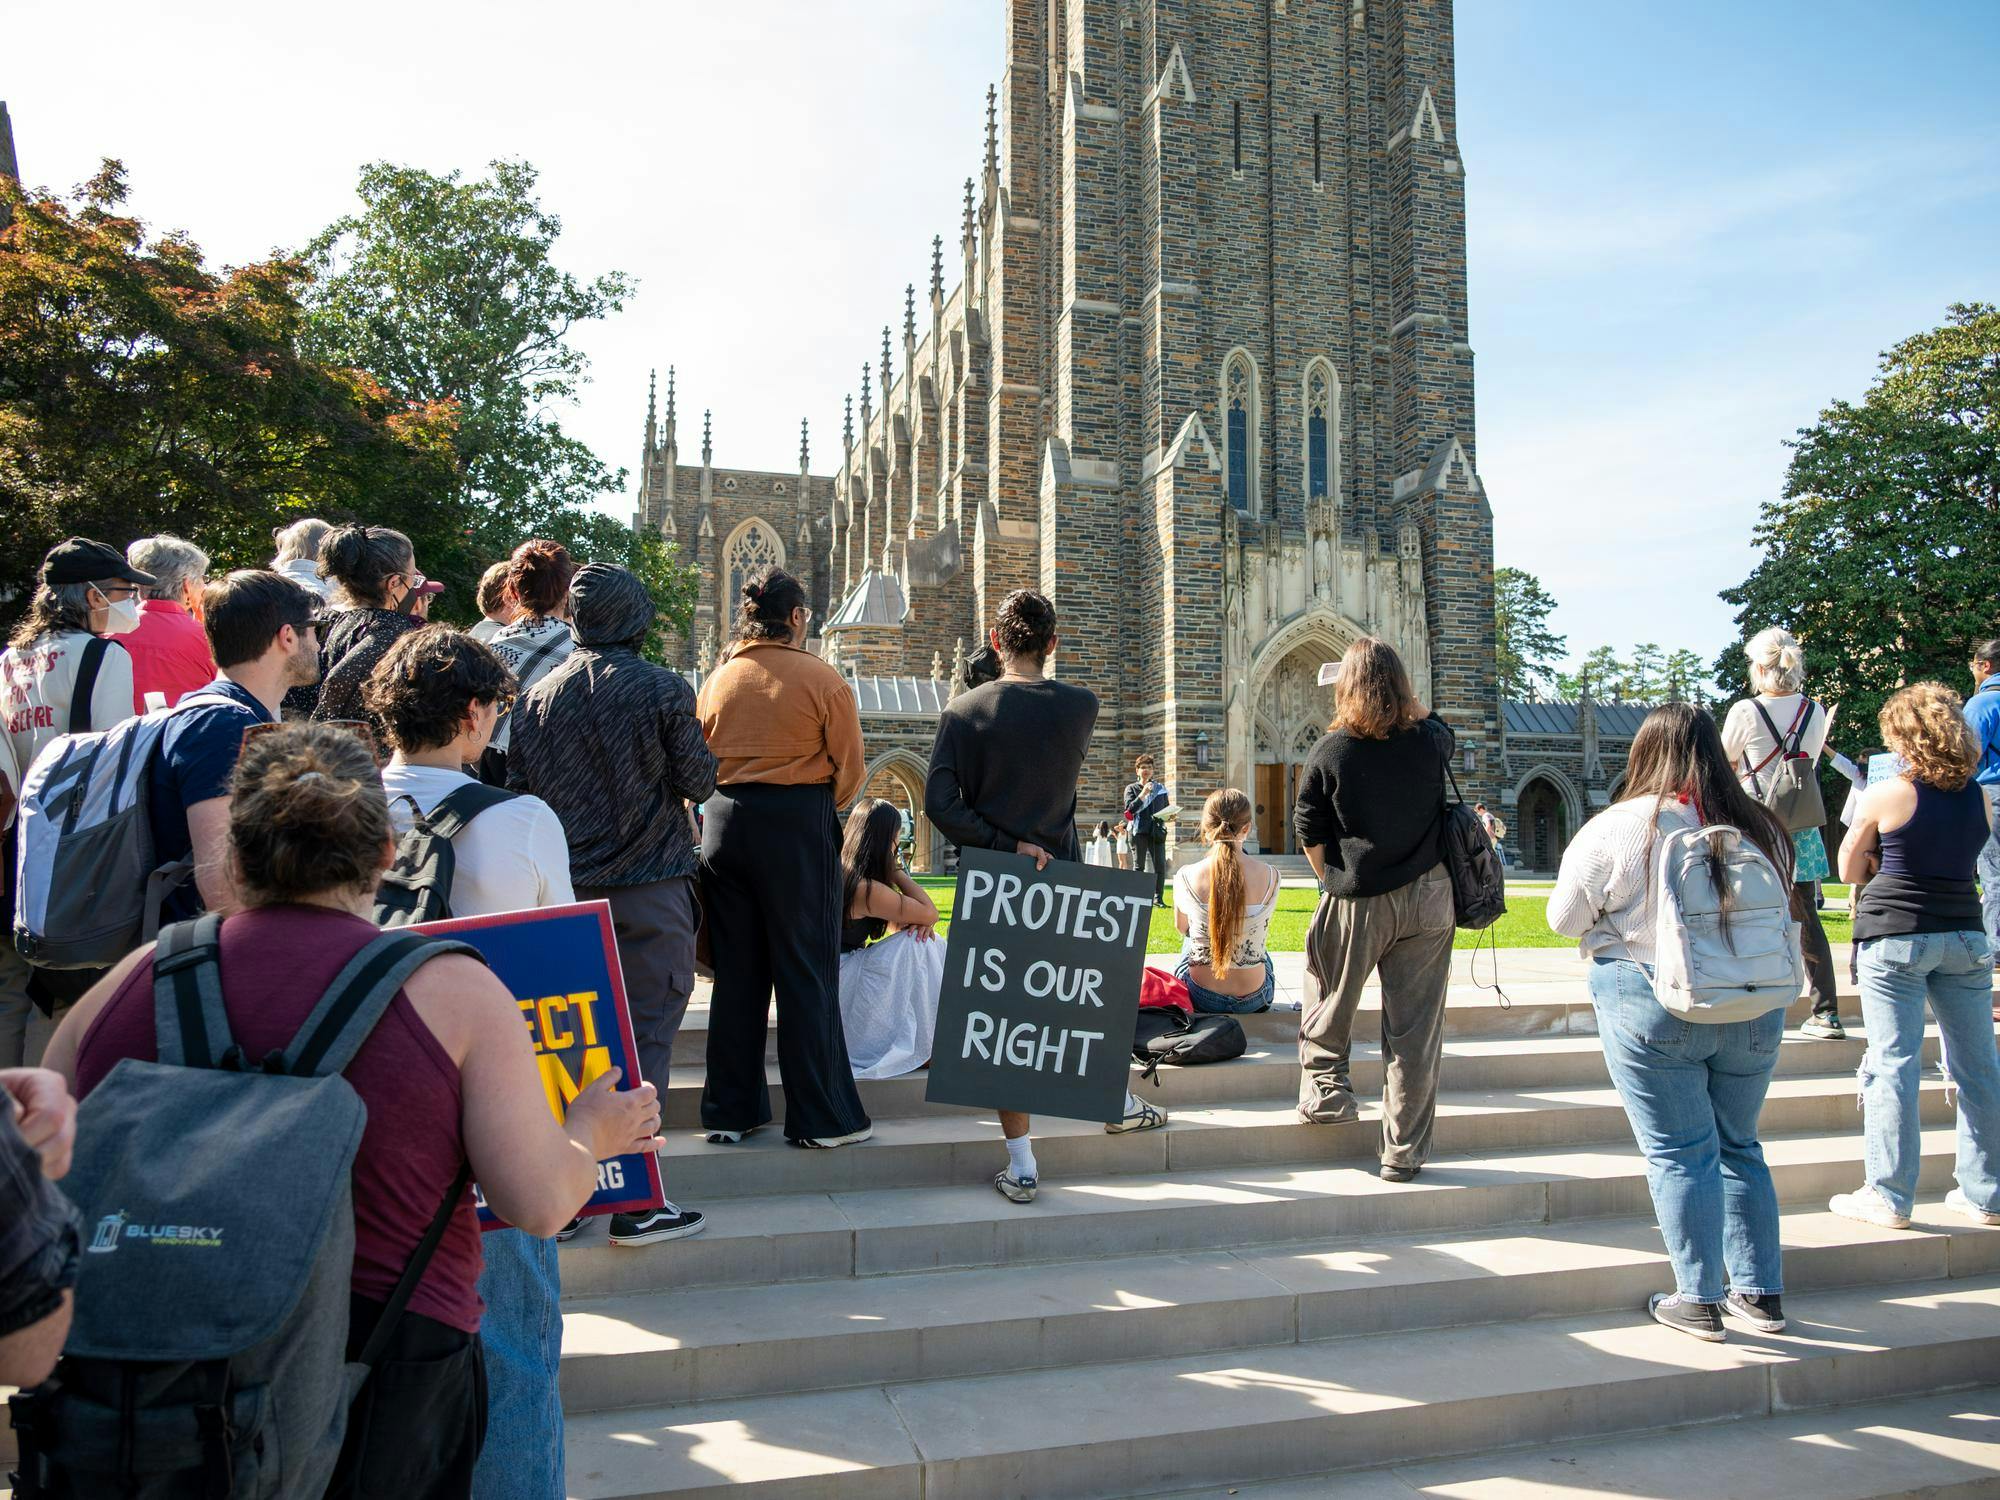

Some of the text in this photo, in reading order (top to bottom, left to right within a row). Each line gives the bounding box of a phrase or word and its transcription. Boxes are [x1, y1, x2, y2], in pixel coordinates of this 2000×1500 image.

[961, 869, 1153, 948] PROTEST
[963, 947, 1105, 1008] IS OUR
[961, 1010, 1105, 1077] RIGHT
[125, 1224, 224, 1239] BLUESKY
